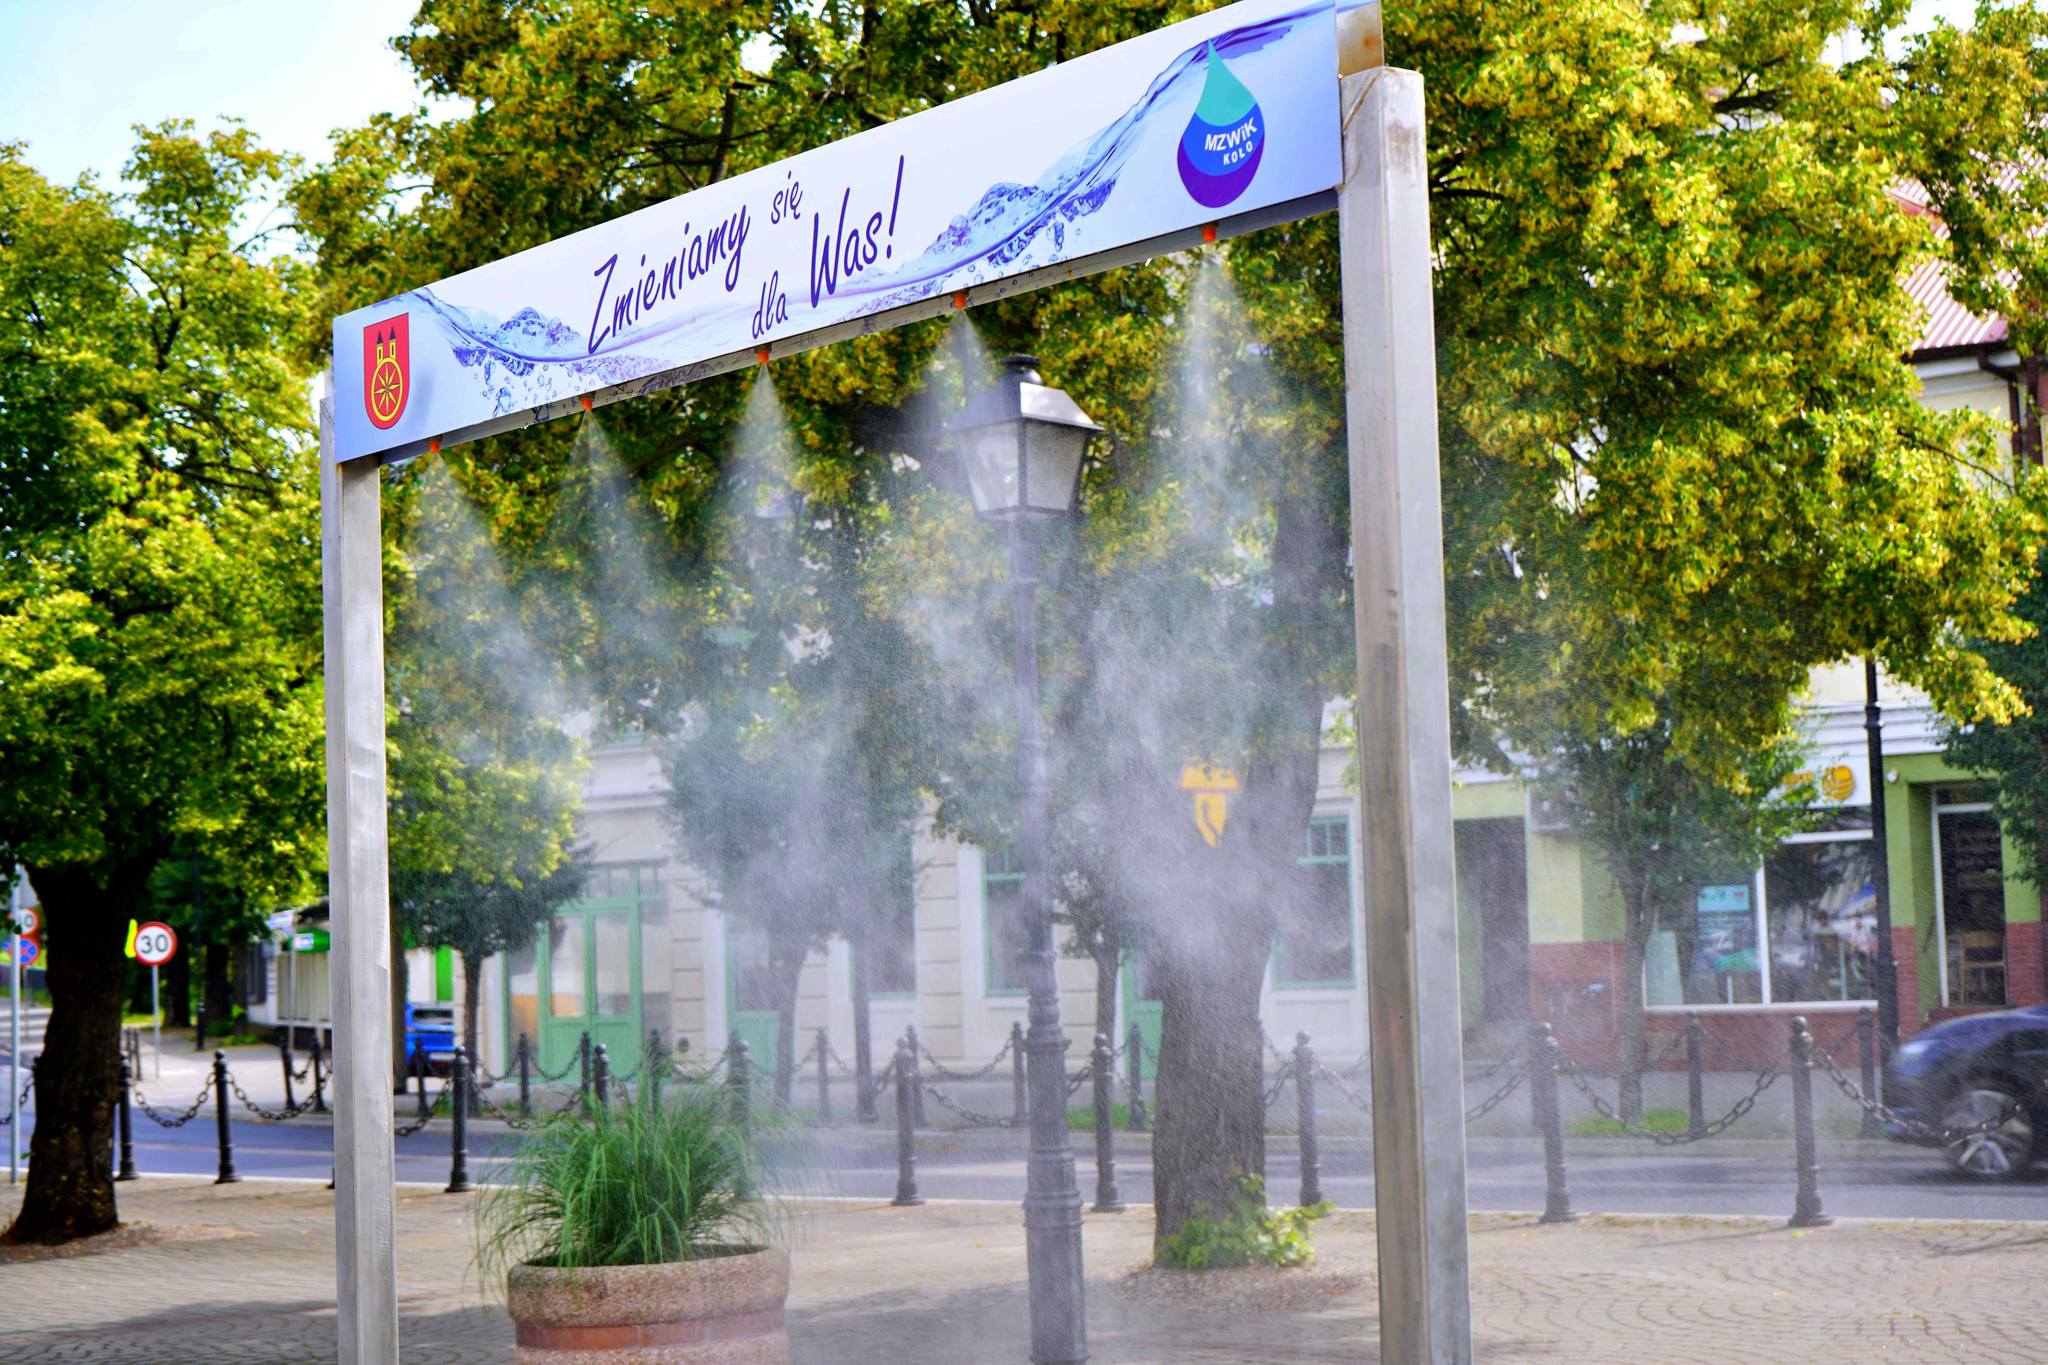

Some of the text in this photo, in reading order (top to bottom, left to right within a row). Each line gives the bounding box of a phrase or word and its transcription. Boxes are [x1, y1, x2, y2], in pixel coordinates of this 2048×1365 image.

[588, 170, 803, 354] Zmieniamy się
[752, 155, 904, 339] dla Was!
[141, 934, 168, 954] 30
